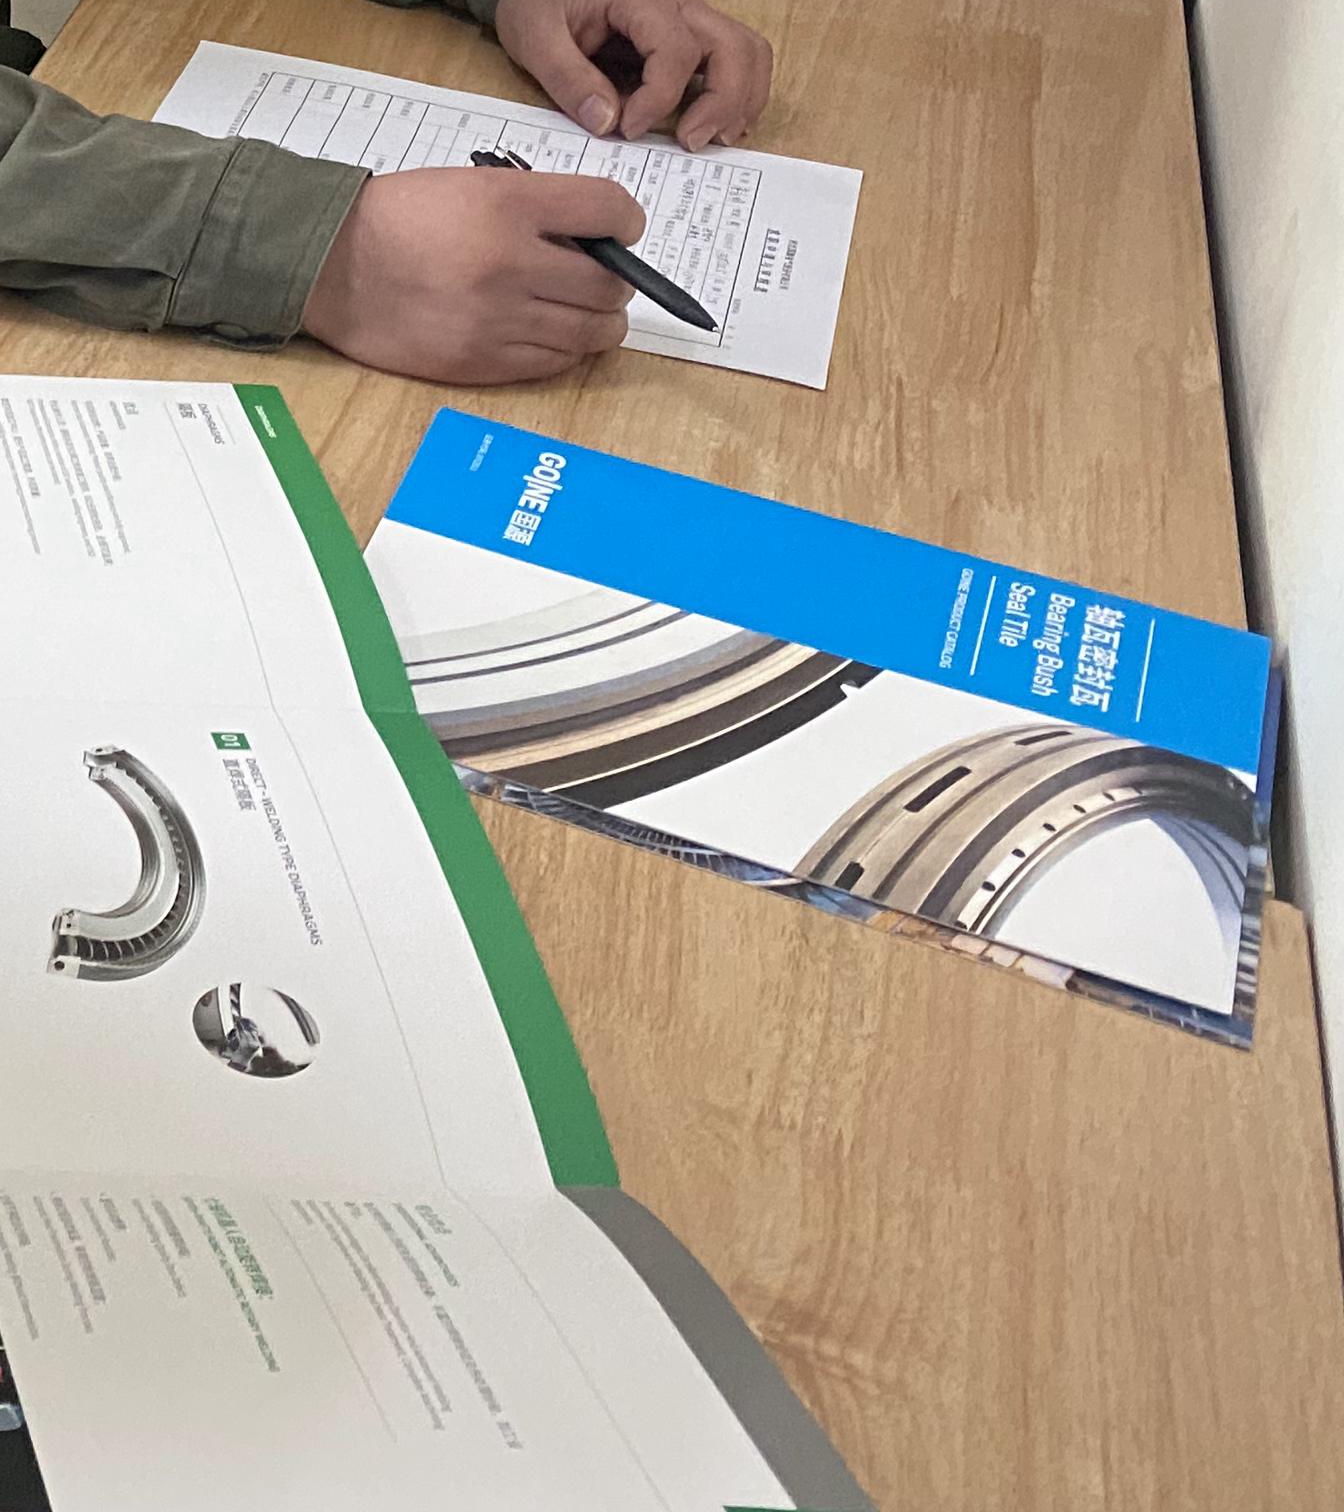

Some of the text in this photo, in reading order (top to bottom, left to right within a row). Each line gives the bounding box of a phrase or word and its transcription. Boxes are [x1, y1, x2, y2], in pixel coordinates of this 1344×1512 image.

[948, 589, 968, 632] PRODUCT
[998, 581, 1037, 649] Seal Tile
[938, 630, 959, 669] CATALOG
[1030, 592, 1076, 697] Bearing Bush
[220, 733, 242, 748] 01
[261, 797, 287, 843] WELDING
[278, 843, 297, 871] TYPE
[287, 872, 323, 946] DIAPHRAGMS
